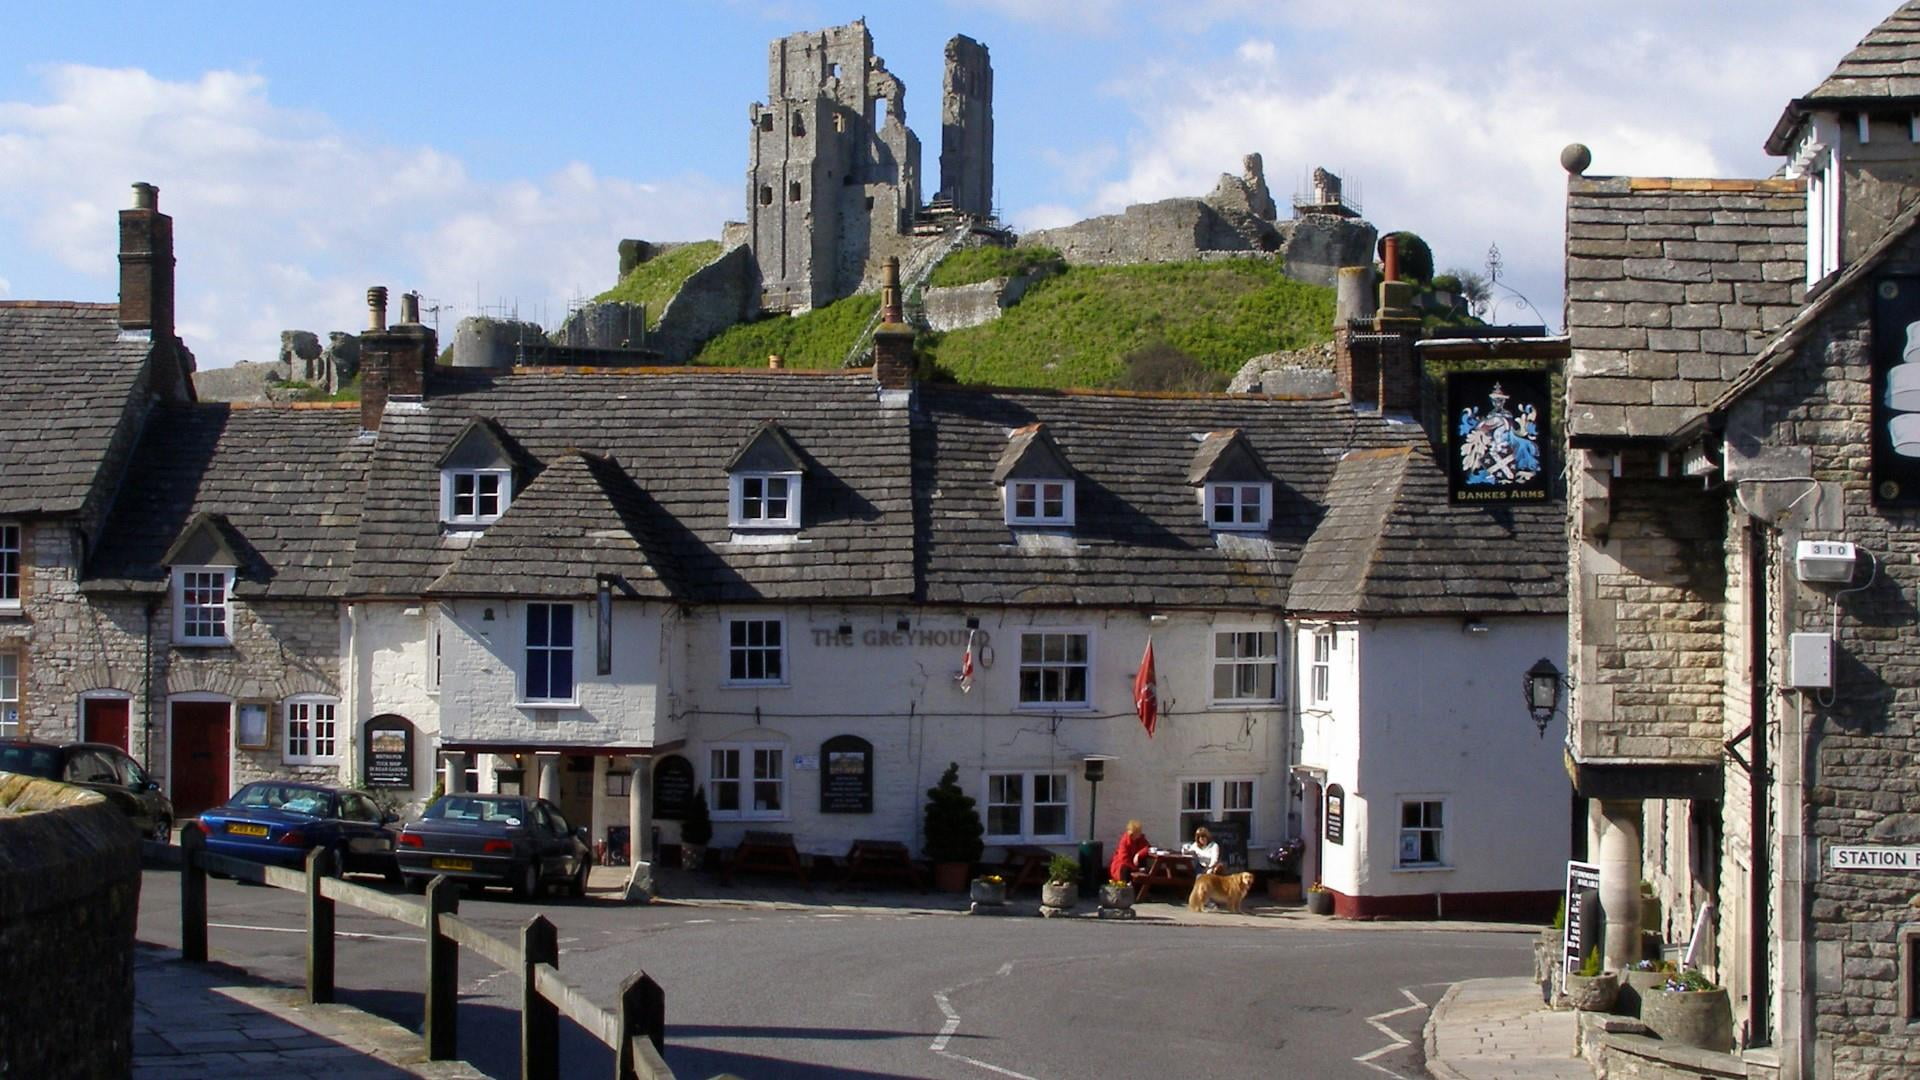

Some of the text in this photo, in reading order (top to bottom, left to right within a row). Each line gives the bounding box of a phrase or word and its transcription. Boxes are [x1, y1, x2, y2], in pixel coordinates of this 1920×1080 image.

[1457, 490, 1545, 499] BANKES ARMS
[1814, 545, 1846, 555] 310
[811, 629, 991, 647] THE GREYHOUND
[1839, 851, 1906, 865] STATION
